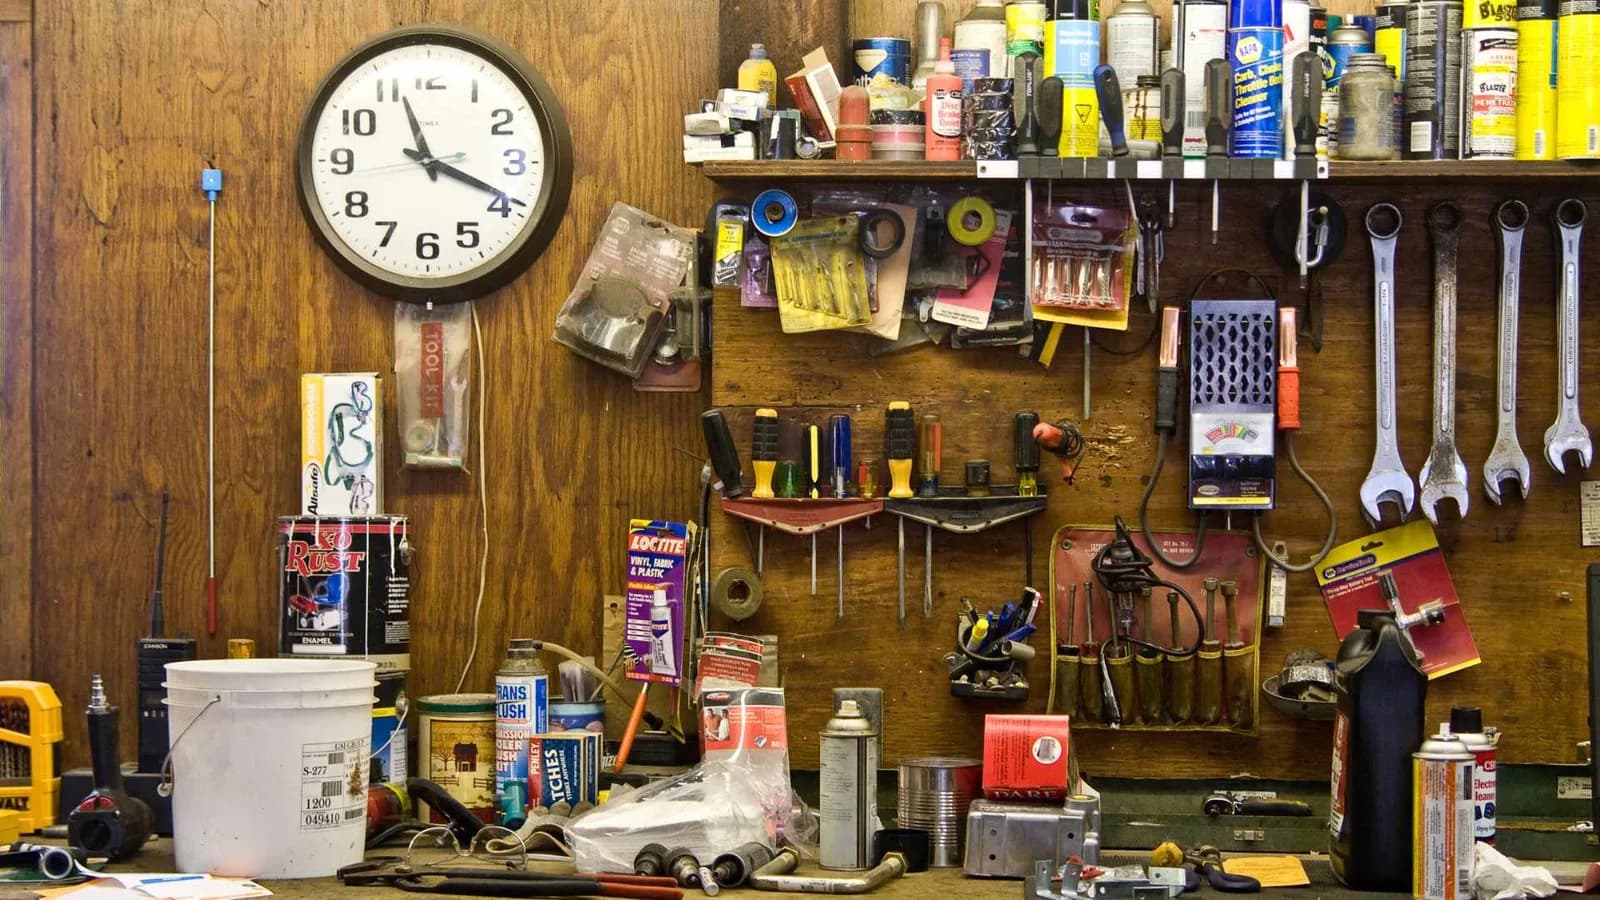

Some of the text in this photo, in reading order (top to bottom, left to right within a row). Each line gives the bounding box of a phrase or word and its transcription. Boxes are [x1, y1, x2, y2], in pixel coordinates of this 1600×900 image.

[377, 79, 399, 103] 11
[415, 74, 447, 91] 12
[471, 79, 478, 103] 1
[1235, 92, 1268, 109] Cleaner
[342, 109, 376, 136] 10
[491, 109, 514, 136] 2
[330, 148, 354, 175] 9
[503, 149, 526, 175] 3
[345, 191, 369, 217] 8
[487, 192, 512, 218] 4
[375, 221, 398, 247] 7
[456, 222, 480, 248] 5
[416, 233, 440, 260] 6
[425, 332, 439, 409] TOOL KIT
[307, 467, 320, 515] Allsafe
[309, 530, 352, 551] KO
[631, 535, 683, 554] LOCTITE
[285, 540, 366, 577] RUST
[630, 556, 675, 569] VINYL, FABRIC
[630, 568, 664, 579] & PLASTIC
[302, 637, 333, 645] ENAMEL
[496, 704, 526, 719] LUSH
[496, 740, 523, 750] OLER
[496, 750, 518, 761] USH
[303, 766, 328, 776] S-277
[544, 749, 565, 802] TCHES
[559, 750, 572, 800] STRIKE ANYWHERE
[1484, 761, 1496, 771] CR
[0, 797, 29, 810] ALT
[306, 798, 331, 810] 1200
[994, 790, 1057, 798] DARE
[305, 813, 340, 825] 049410
